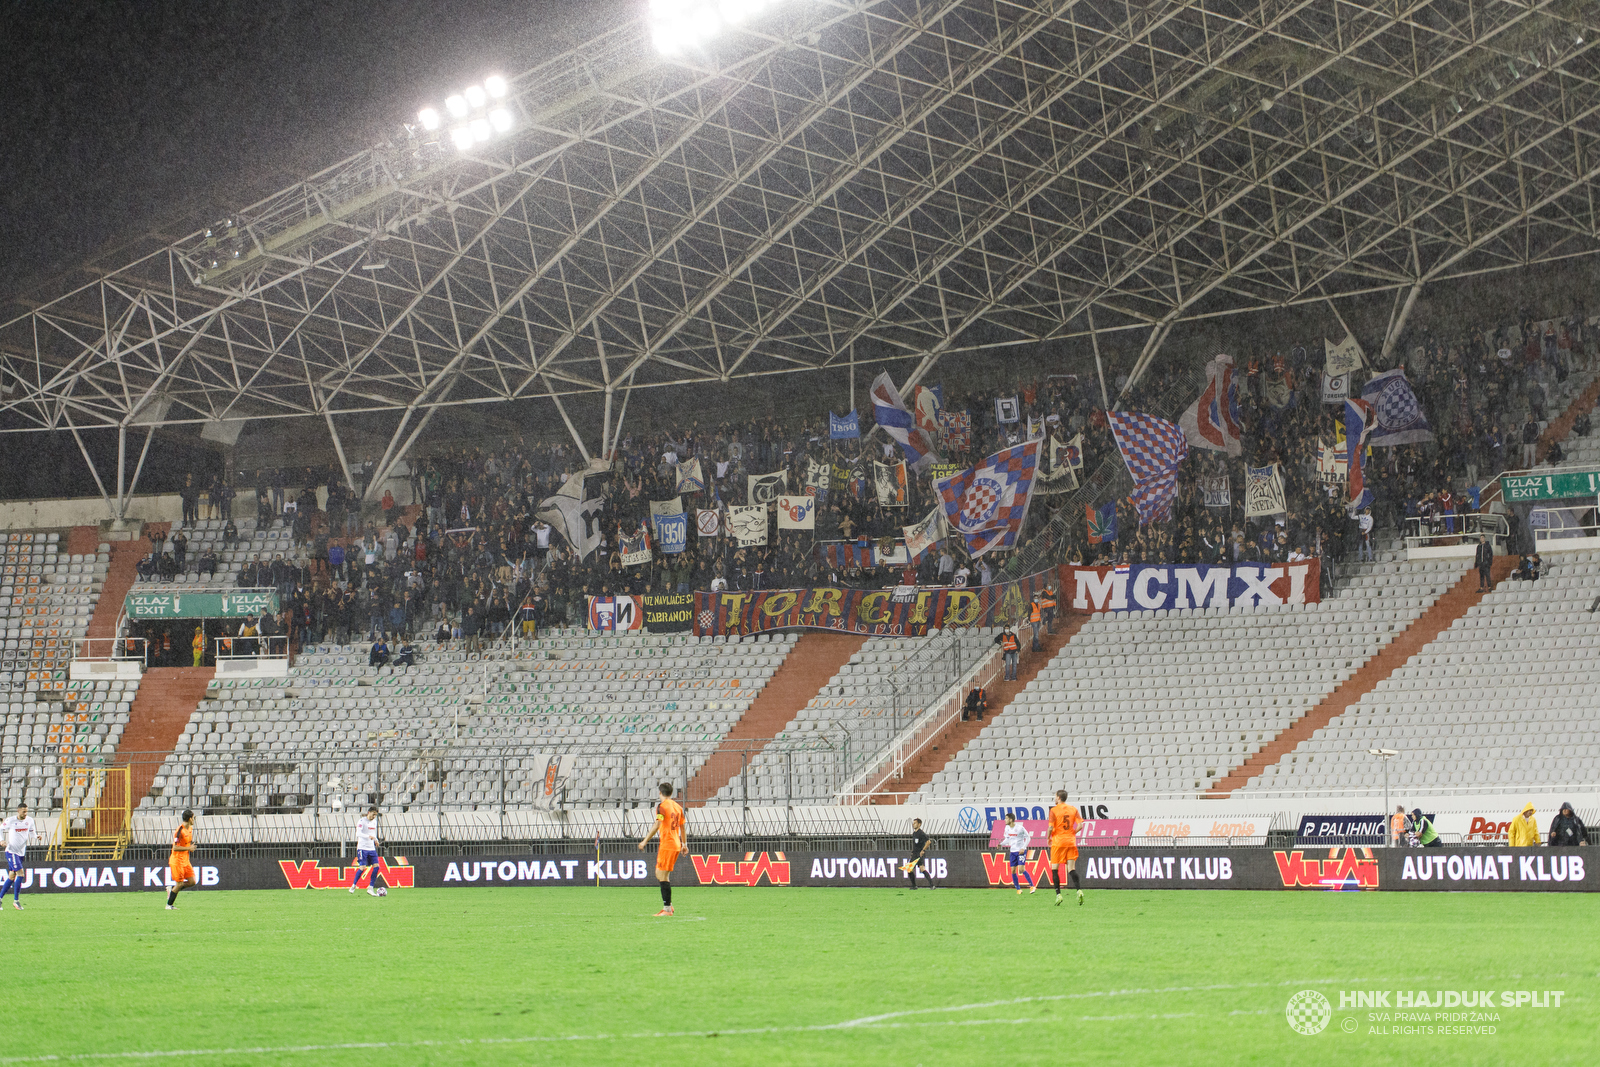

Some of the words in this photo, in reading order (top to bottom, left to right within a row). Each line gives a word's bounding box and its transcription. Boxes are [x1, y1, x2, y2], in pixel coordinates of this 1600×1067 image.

[1506, 477, 1543, 488] IZLAZ
[1511, 488, 1539, 498] EXIT
[660, 522, 684, 545] 1950
[1073, 565, 1309, 610] MCMXI
[130, 596, 170, 606] IZLAZ
[232, 595, 270, 604] IZLAZ
[135, 606, 166, 615] EXIT
[646, 610, 693, 623] ZABRANOM
[1062, 815, 1070, 831] 5
[443, 860, 578, 882] AUTOMAT
[587, 859, 648, 880] KLUB
[810, 857, 898, 879] AUTOMAT
[1085, 856, 1175, 880] AUTOMAT
[1180, 857, 1233, 880] KLUB
[1401, 855, 1513, 880] AUTOMAT
[1519, 855, 1586, 881] KLUB
